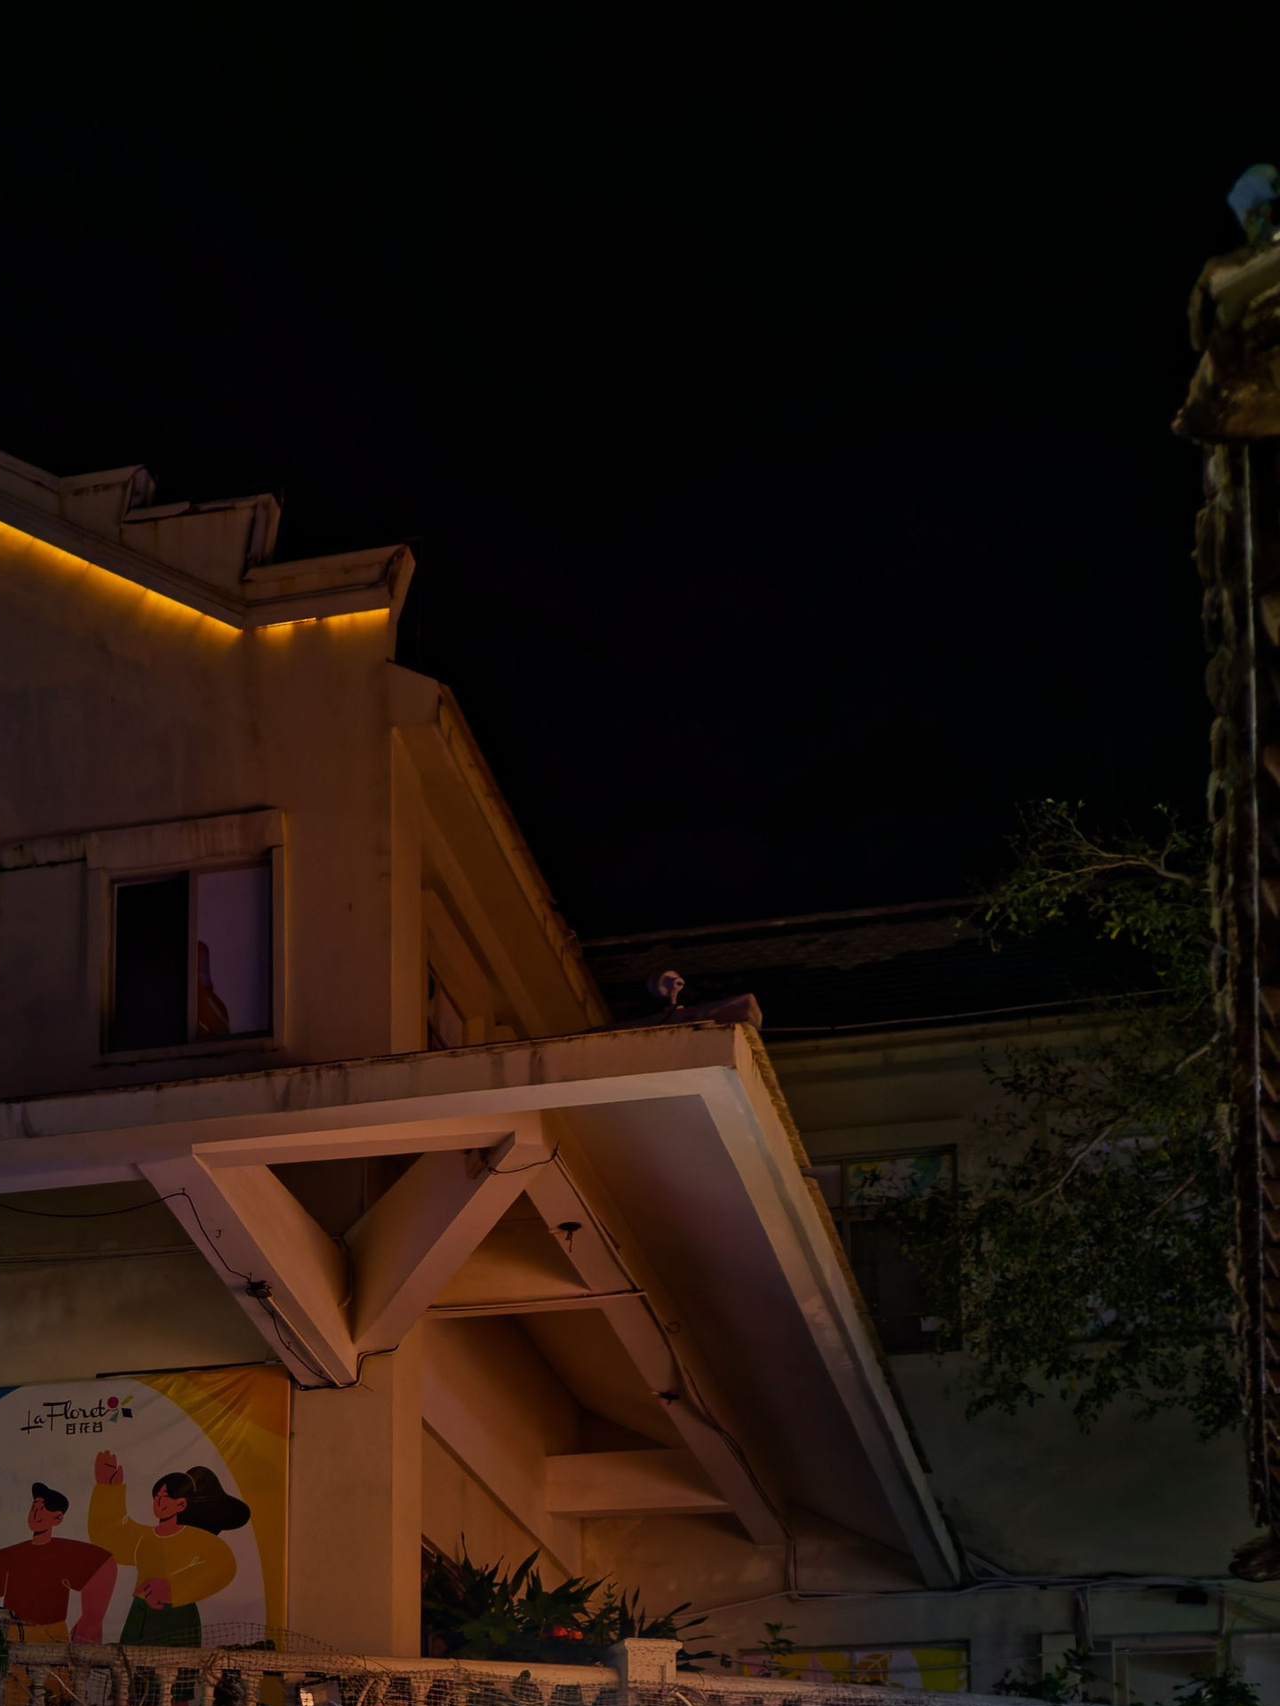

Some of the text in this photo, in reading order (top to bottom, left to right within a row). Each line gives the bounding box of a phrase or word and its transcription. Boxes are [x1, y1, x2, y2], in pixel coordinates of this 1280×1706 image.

[43, 1399, 118, 1431] Floret
[66, 1421, 103, 1435] 百花谷
